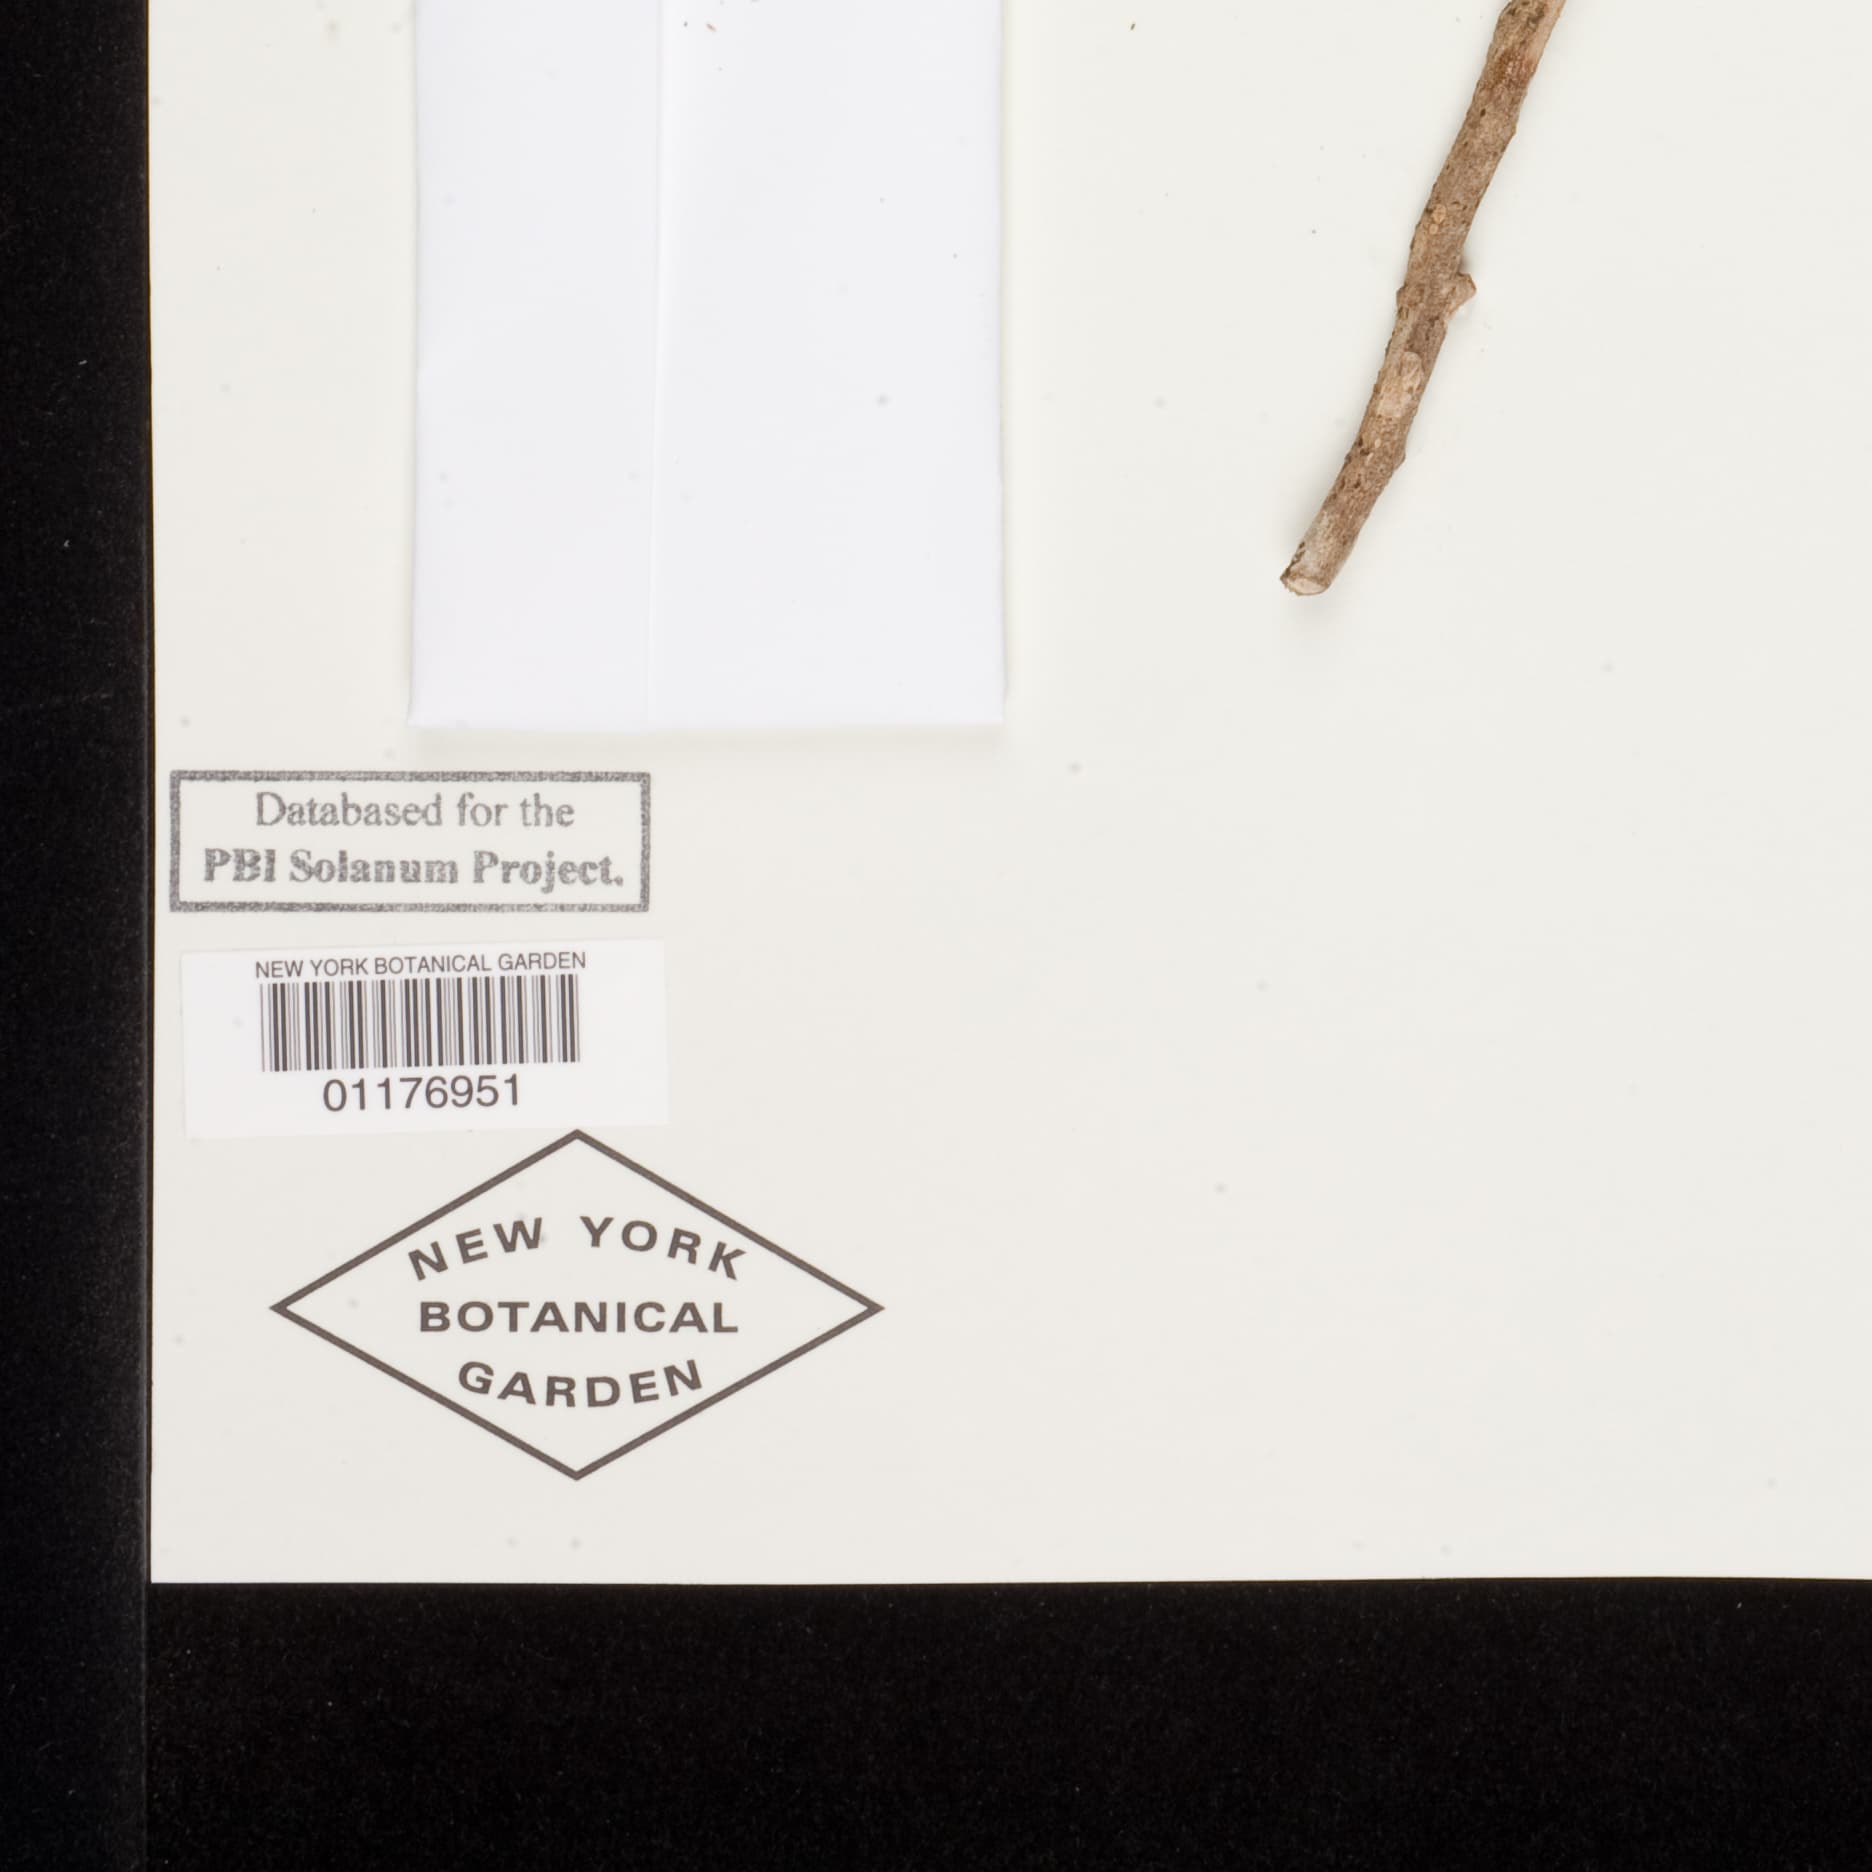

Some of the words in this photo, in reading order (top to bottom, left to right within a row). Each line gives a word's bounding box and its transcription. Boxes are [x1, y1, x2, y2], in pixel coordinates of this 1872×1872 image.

[255, 791, 443, 827] Databased
[456, 791, 509, 827] for
[519, 792, 575, 828] the
[203, 847, 277, 883] PBI
[289, 848, 459, 885] Solanum
[473, 850, 624, 894] Project.
[255, 960, 304, 979] NEW
[310, 957, 369, 977] YORK
[374, 954, 492, 975] BOTANICAL
[498, 951, 586, 971] GARDEN
[322, 1073, 518, 1113] 01176951
[408, 1217, 542, 1281] NEW
[580, 1216, 746, 1280] YORK
[420, 1301, 738, 1333] BOTANICAL
[458, 1359, 702, 1408] GARDEN
